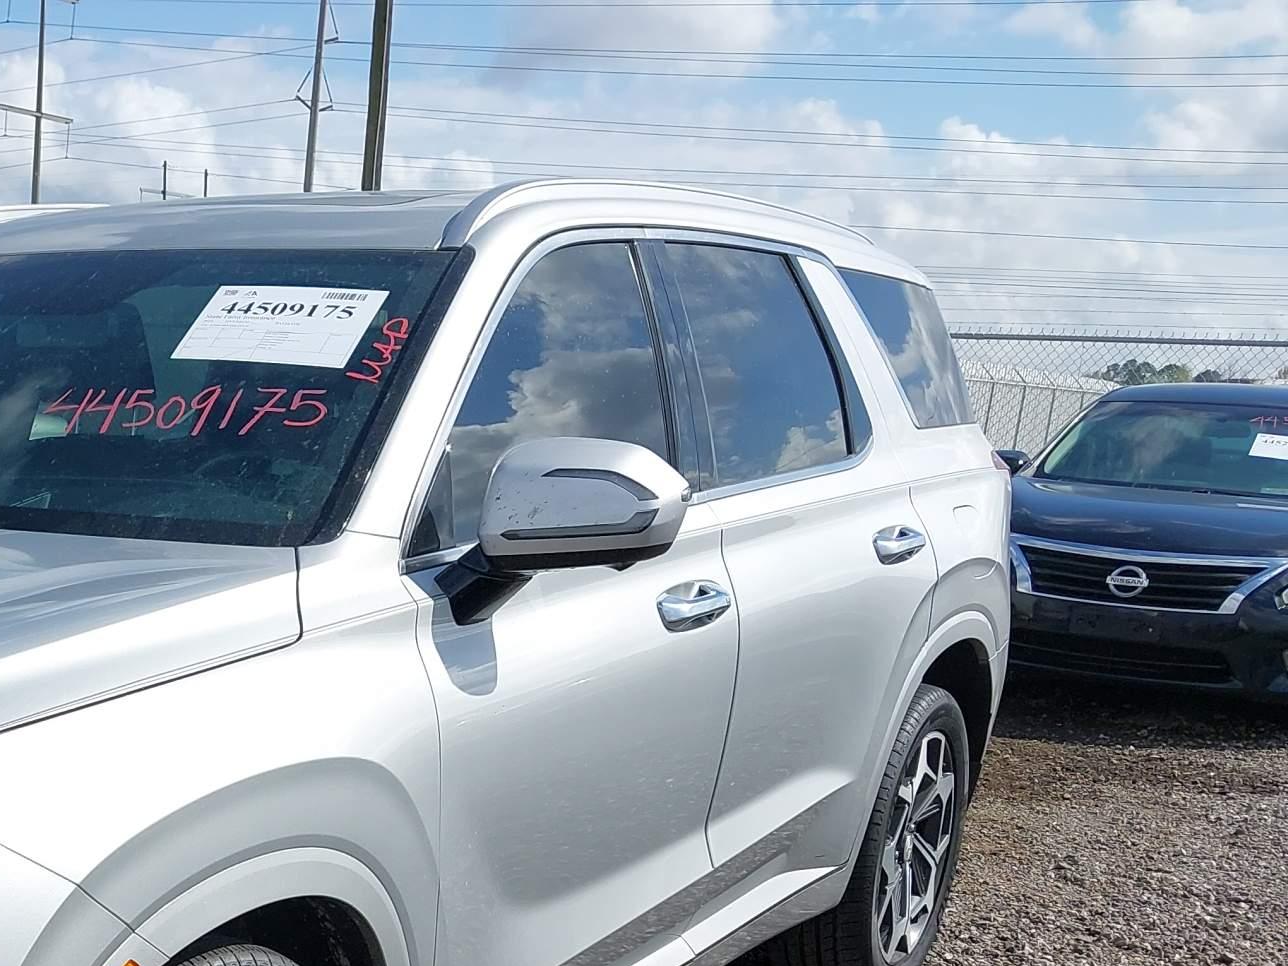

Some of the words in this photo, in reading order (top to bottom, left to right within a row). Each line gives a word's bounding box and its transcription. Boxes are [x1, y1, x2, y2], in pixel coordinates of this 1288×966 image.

[220, 301, 357, 320] 44509175
[43, 384, 328, 436] 44509175
[1111, 577, 1144, 586] NISSAN
